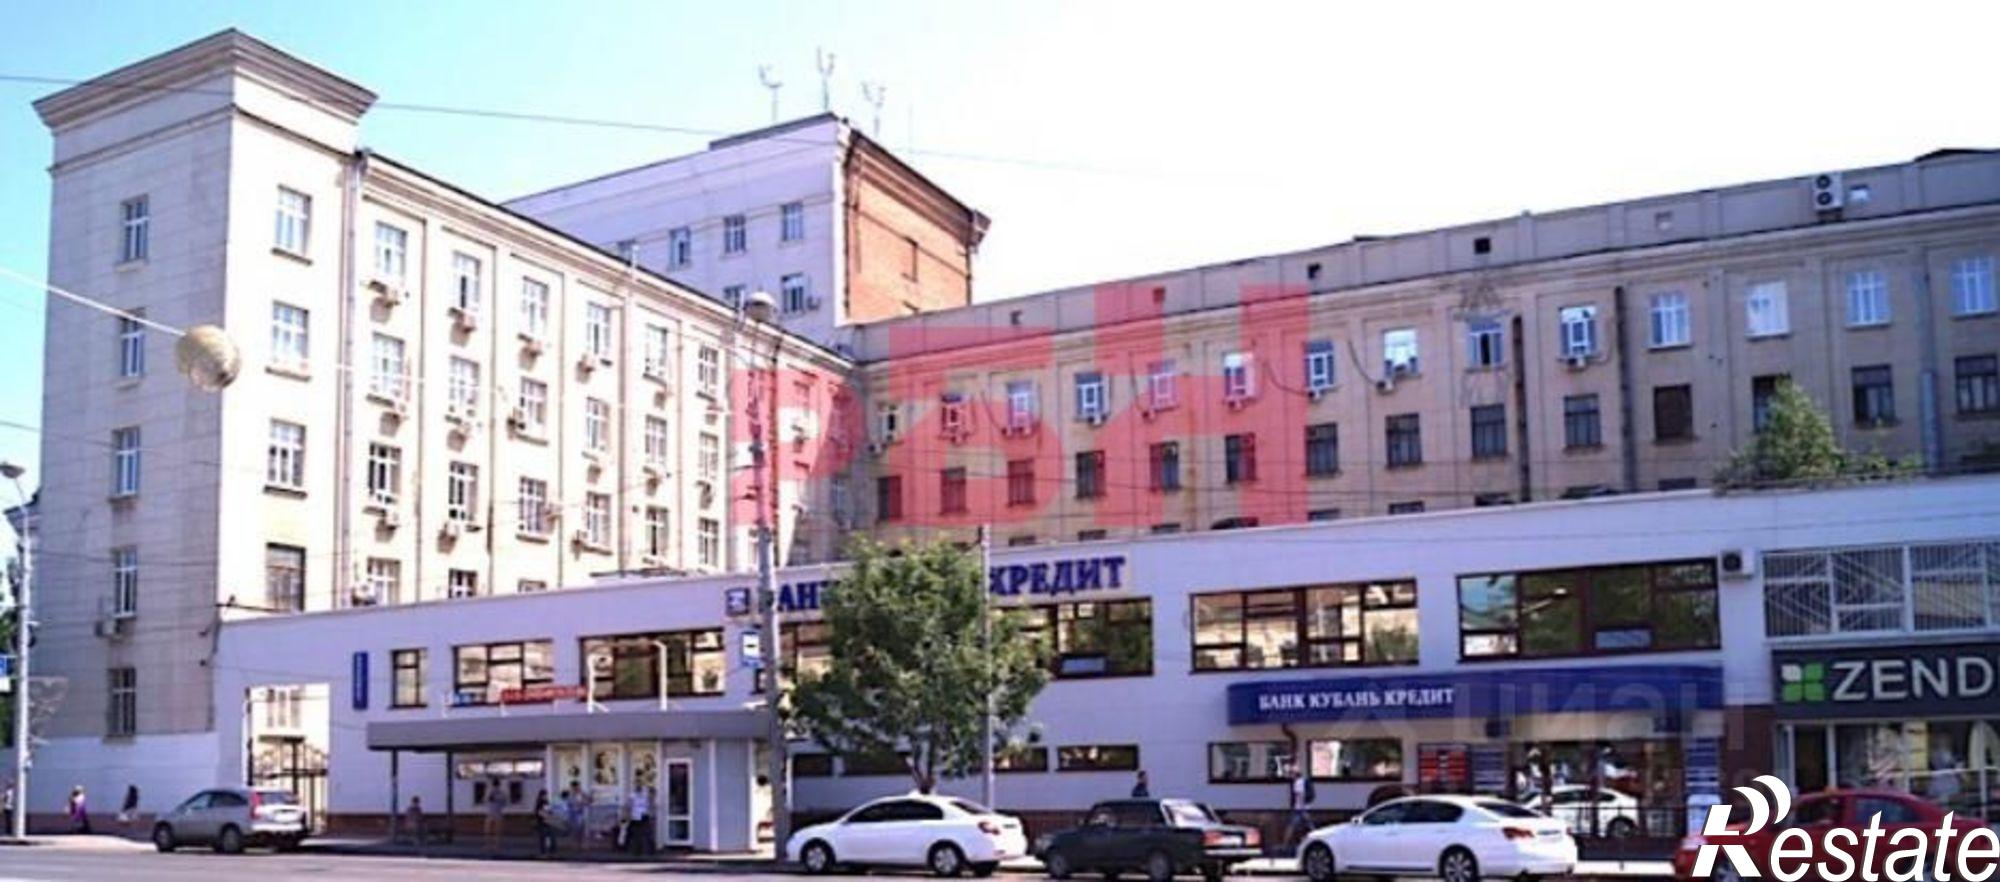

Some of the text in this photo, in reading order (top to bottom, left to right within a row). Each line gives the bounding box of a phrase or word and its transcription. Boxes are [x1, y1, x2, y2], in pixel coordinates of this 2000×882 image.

[1833, 656, 2000, 700] ZEND
[1259, 687, 1454, 711] БАНК КУБАНЬ КРЕДИТ
